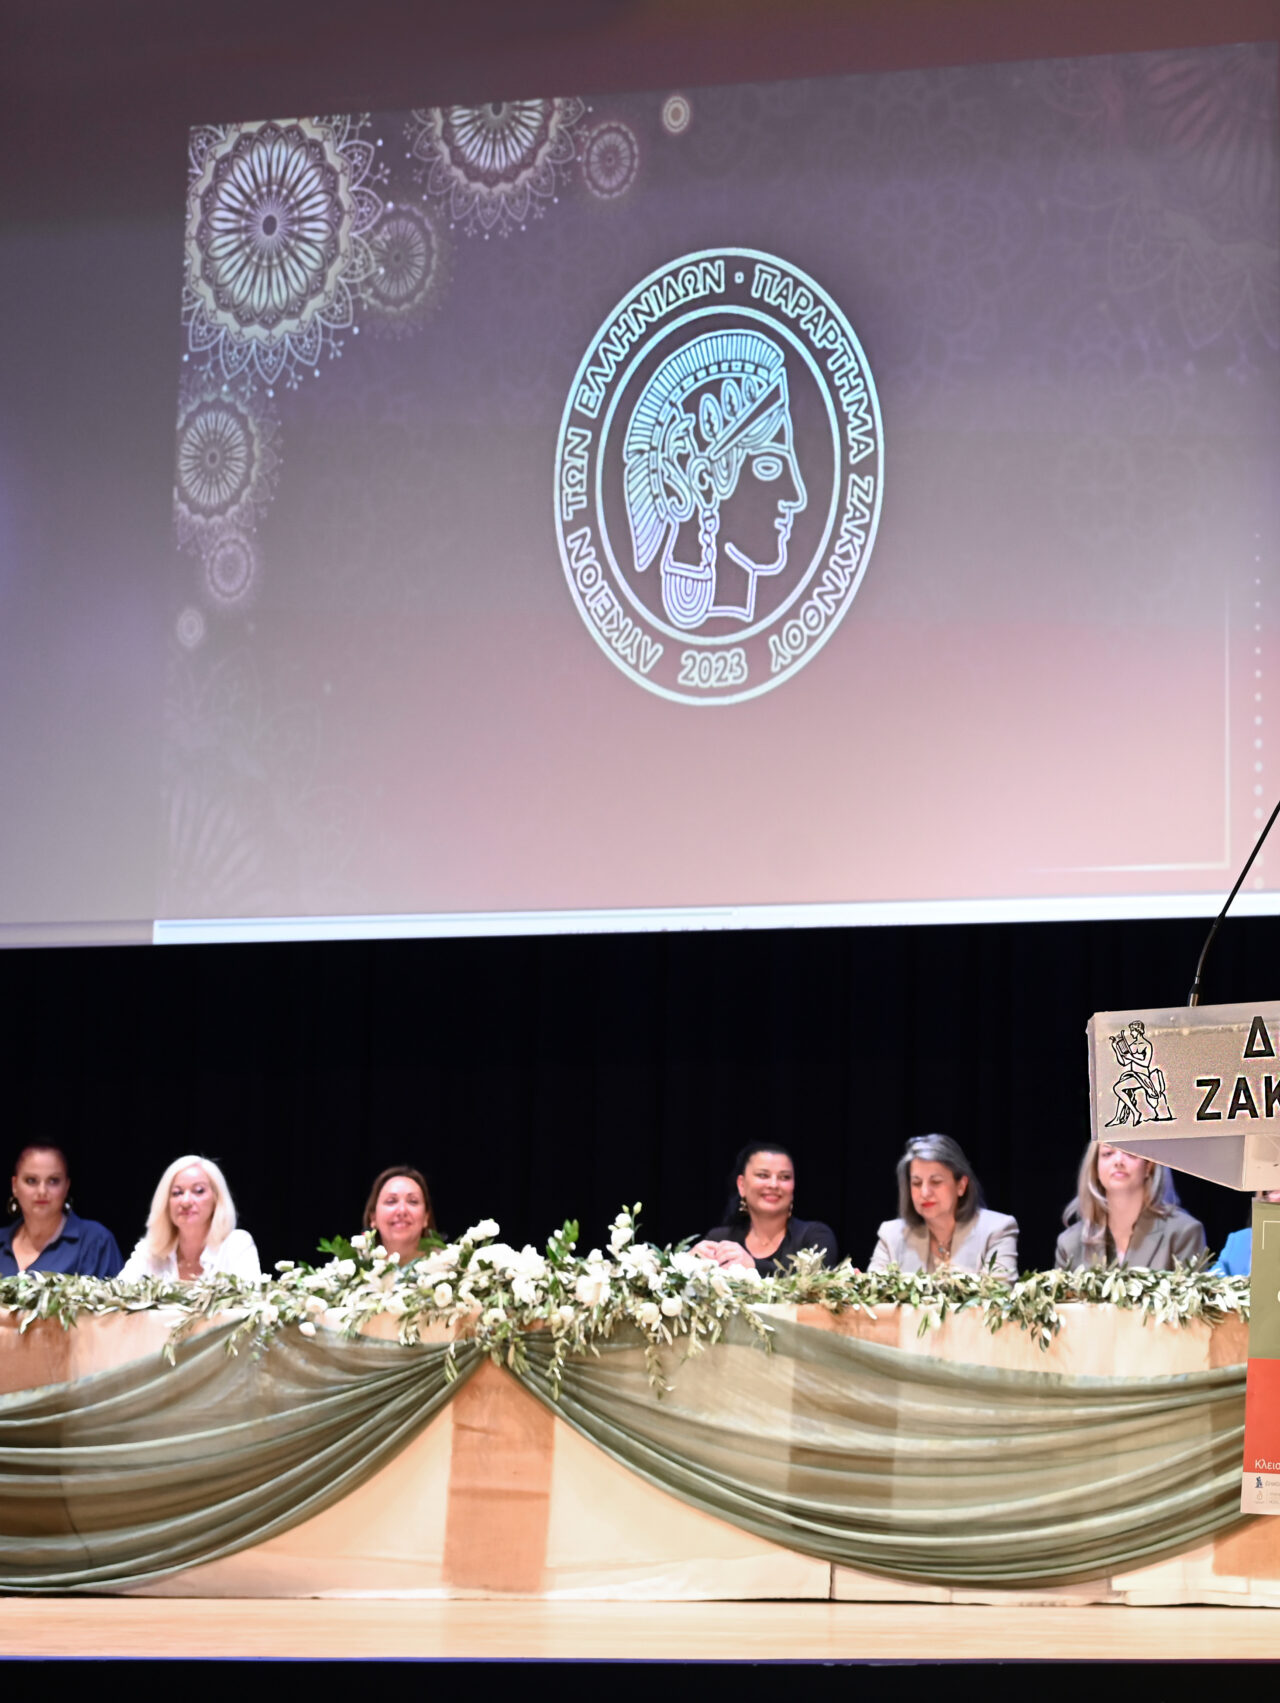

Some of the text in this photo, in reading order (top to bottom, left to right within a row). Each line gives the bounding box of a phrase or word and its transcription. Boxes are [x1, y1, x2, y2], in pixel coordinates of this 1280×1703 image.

[562, 261, 875, 673] ΛΥΚΕΙΟΝ ΤΩΝ ΕΛΛΗΝΙΔΩΝ ΠΑΡΑΡΤΗΜΑ ΖΑΚΥΝΘΟΥ
[678, 649, 748, 687] 2023
